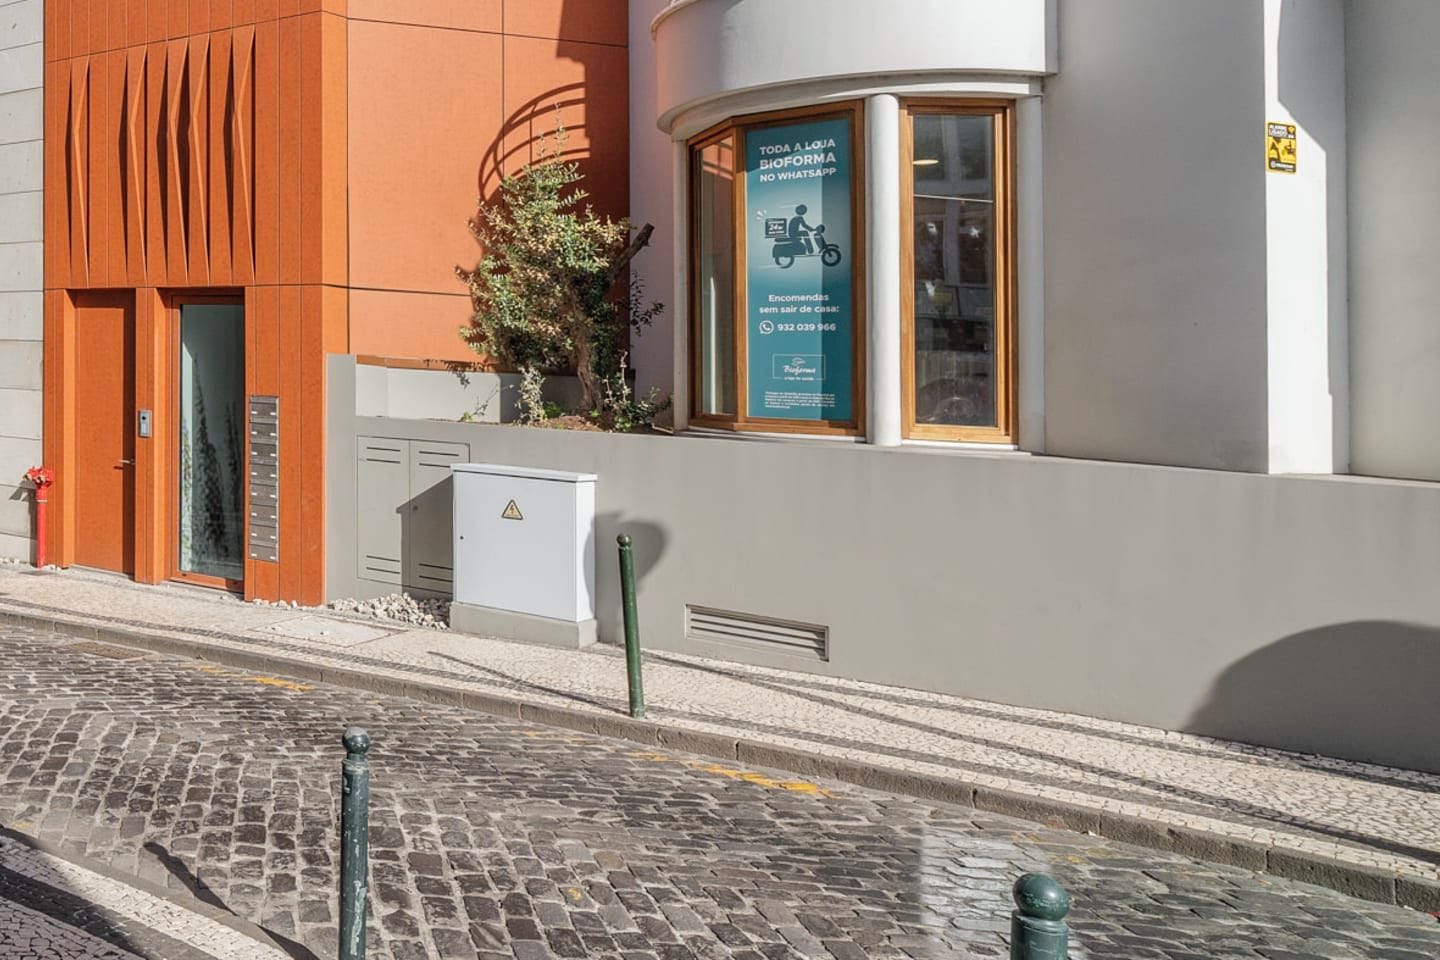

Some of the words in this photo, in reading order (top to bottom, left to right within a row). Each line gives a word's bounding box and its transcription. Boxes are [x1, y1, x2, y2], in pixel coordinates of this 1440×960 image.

[759, 144, 791, 155] TODA
[794, 143, 802, 151] A
[804, 139, 836, 150] LOJA
[759, 152, 837, 170] BIOFORMA
[759, 173, 775, 183] NO
[777, 167, 837, 181] WHATSAPP
[768, 293, 829, 302] Encomendas
[759, 306, 778, 314] sem
[780, 305, 798, 313] sair
[799, 305, 812, 313] de
[814, 305, 840, 313] casa:
[777, 323, 795, 331] 932
[796, 323, 816, 331] 039
[817, 323, 836, 331] 966
[783, 365, 816, 375] Bioforma
